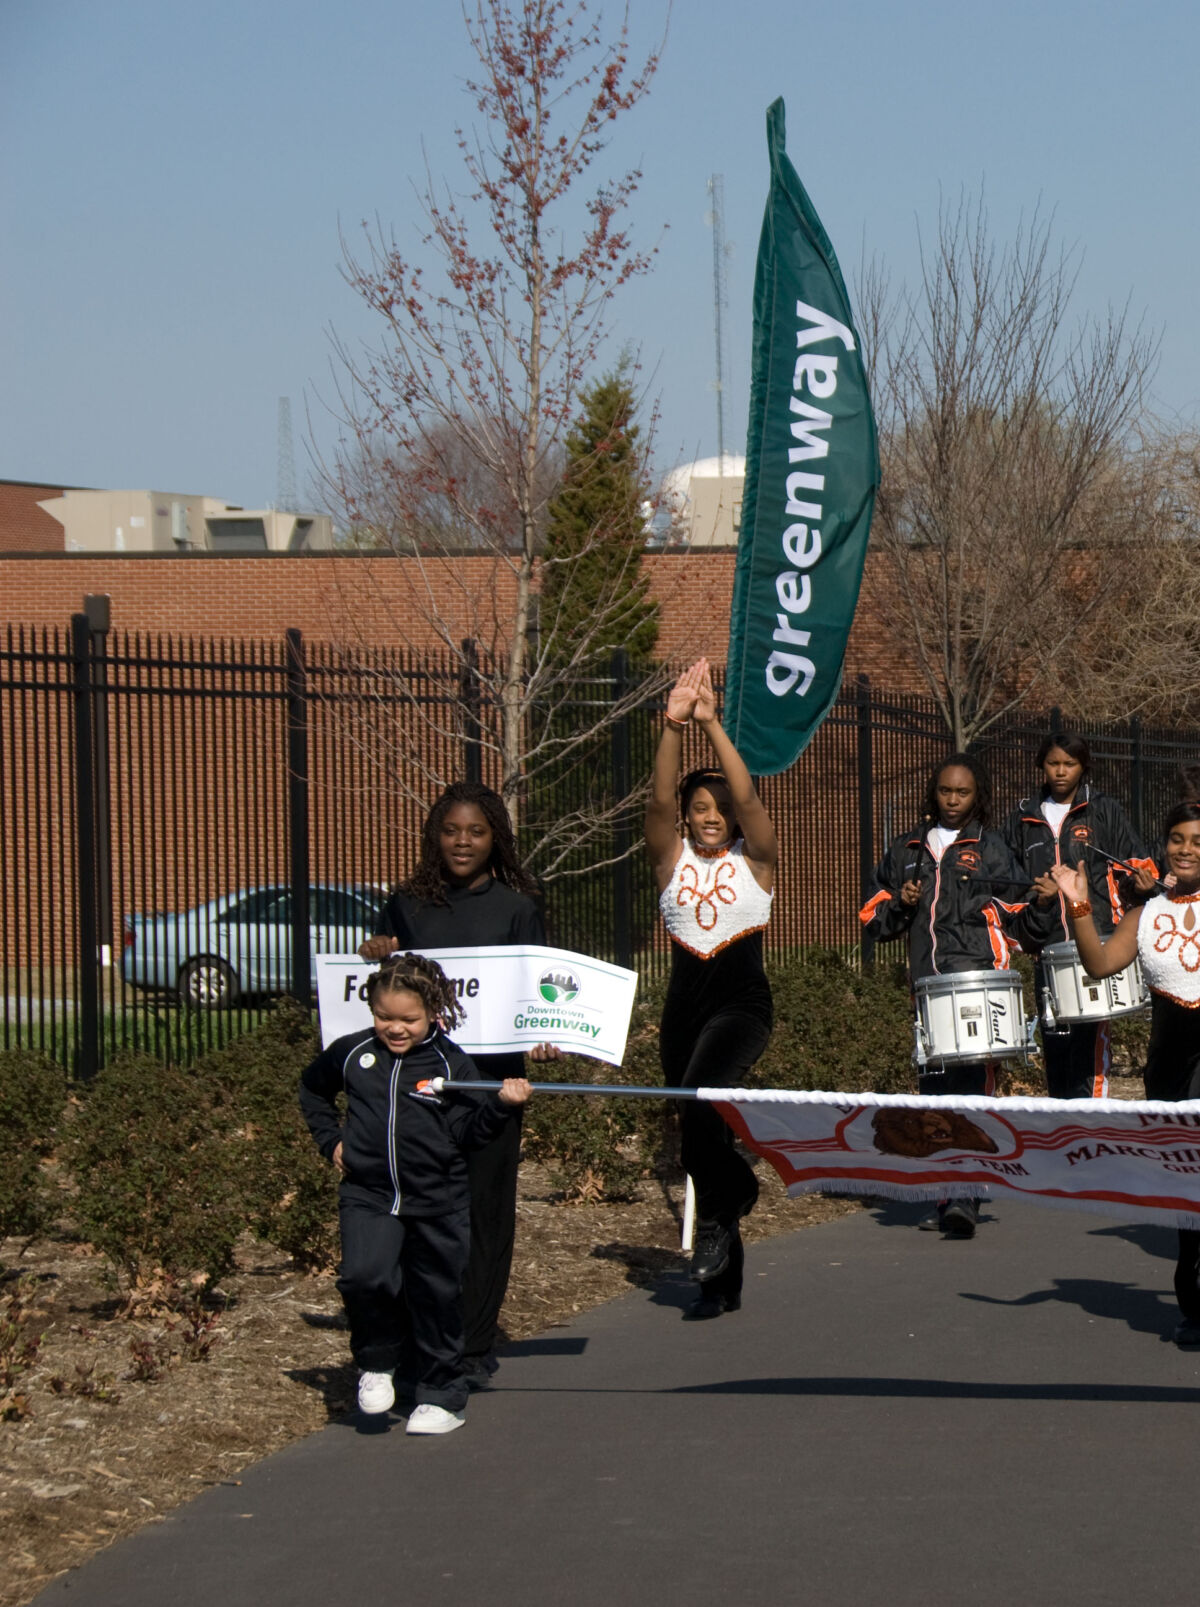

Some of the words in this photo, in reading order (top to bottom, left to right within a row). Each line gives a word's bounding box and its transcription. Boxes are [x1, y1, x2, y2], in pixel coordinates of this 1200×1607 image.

[763, 299, 857, 698] greenway
[527, 1005, 585, 1019] Downtown
[988, 997, 1008, 1045] Pearl
[514, 1013, 602, 1038] Greenway
[973, 1158, 1030, 1176] TEAM
